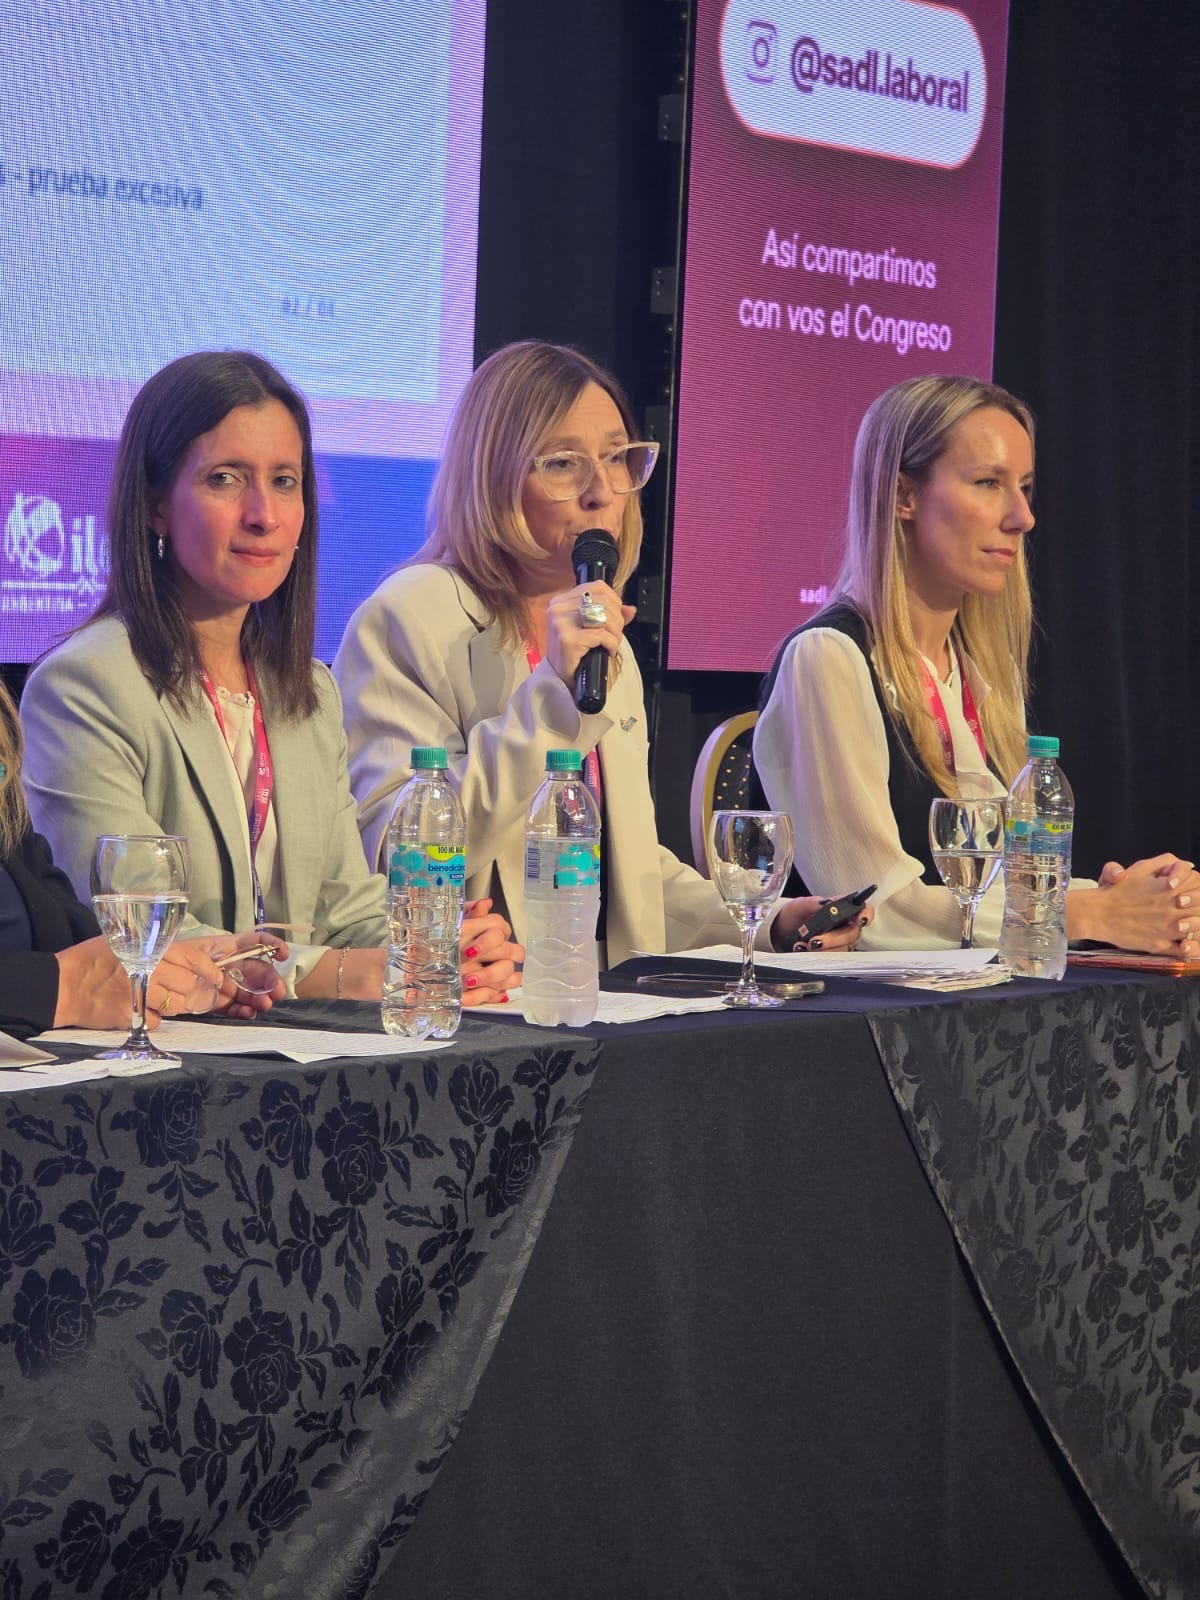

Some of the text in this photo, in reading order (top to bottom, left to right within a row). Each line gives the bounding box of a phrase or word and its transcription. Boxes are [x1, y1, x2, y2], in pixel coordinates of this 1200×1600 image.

[791, 36, 969, 113] @sadl.laboral
[28, 166, 108, 199] prueba
[115, 178, 203, 211] excesiva
[761, 228, 937, 288] Así compartimos
[739, 298, 952, 355] con vos el Congreso
